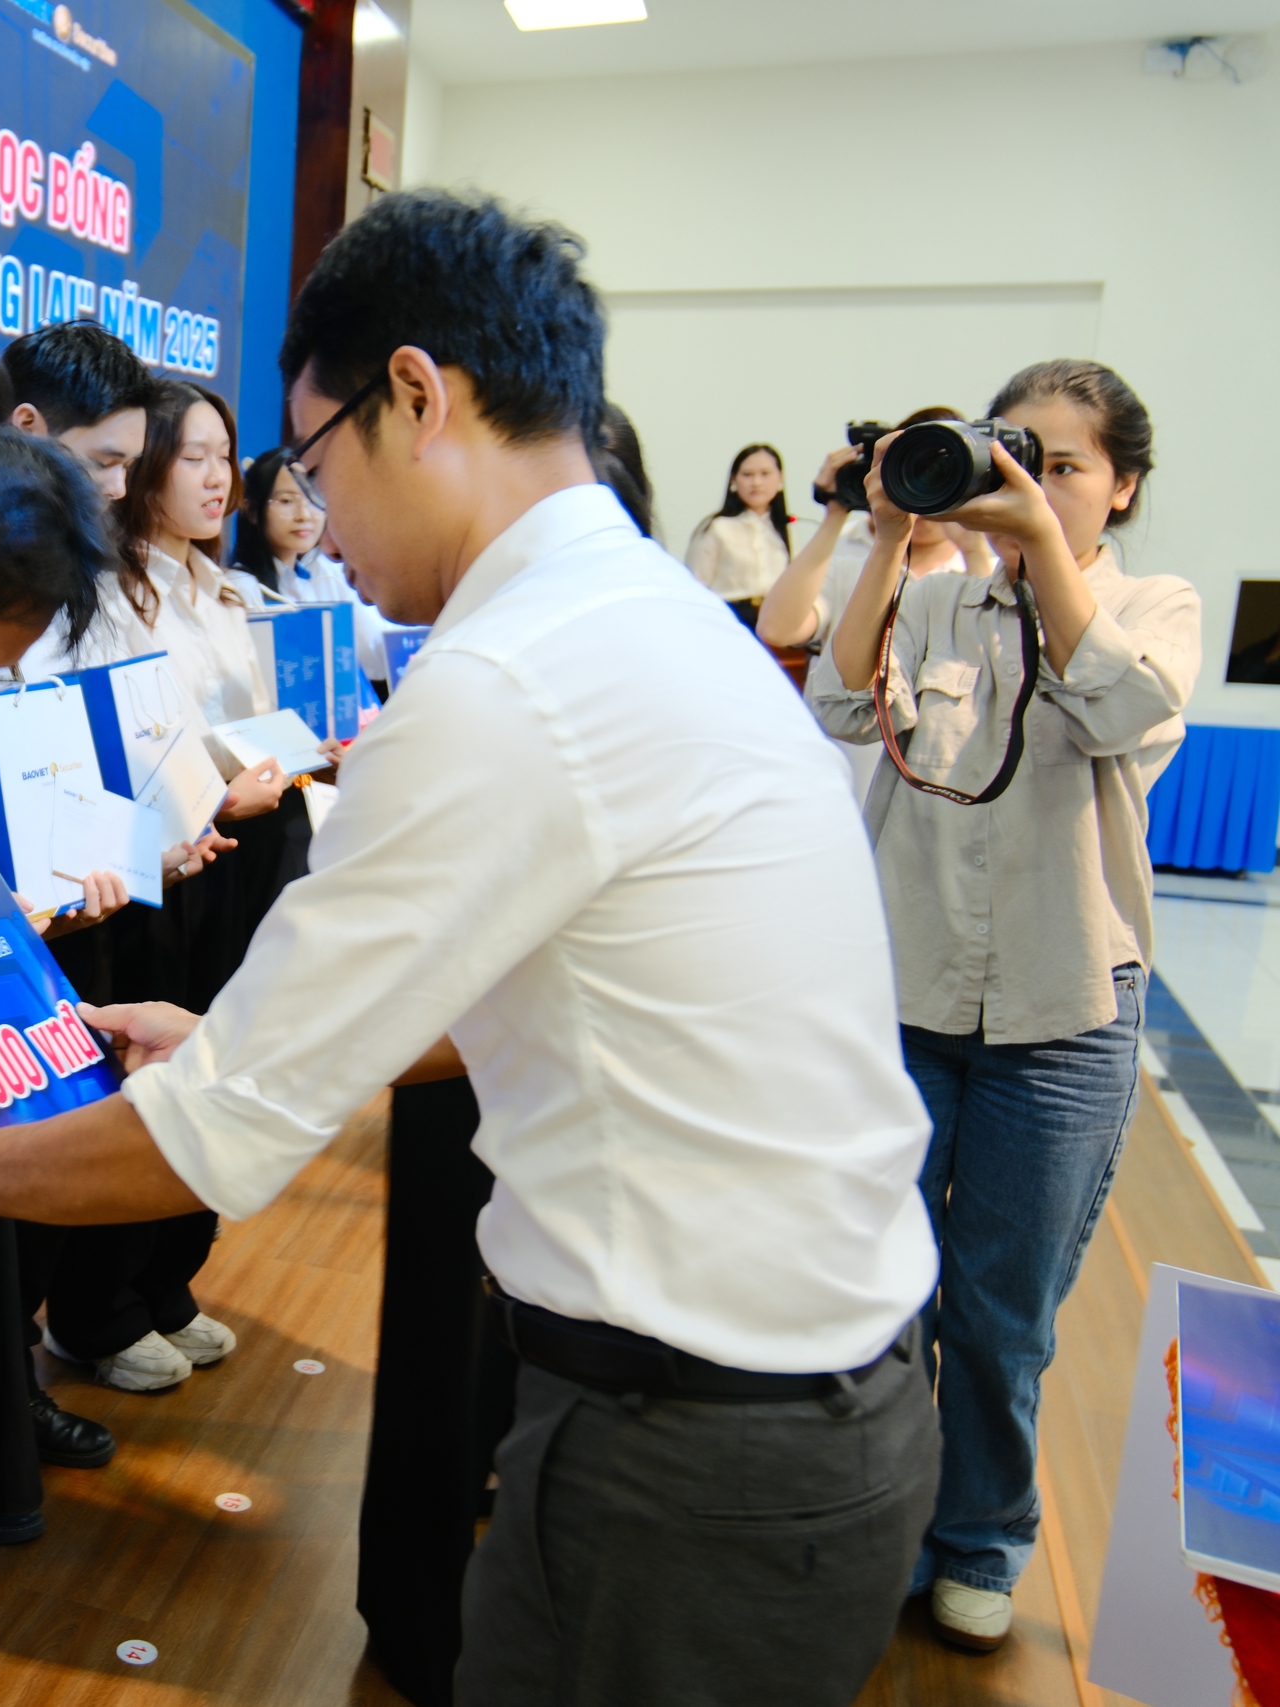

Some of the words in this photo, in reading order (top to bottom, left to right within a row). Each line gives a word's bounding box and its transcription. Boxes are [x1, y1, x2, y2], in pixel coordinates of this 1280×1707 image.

[48, 141, 131, 253] BỔNG
[99, 279, 162, 366] NĂM
[162, 306, 220, 378] 2025
[22, 766, 49, 780] BAOVIET
[23, 998, 106, 1079] vnđ
[223, 1496, 242, 1509] 15
[124, 1645, 148, 1661] 14
